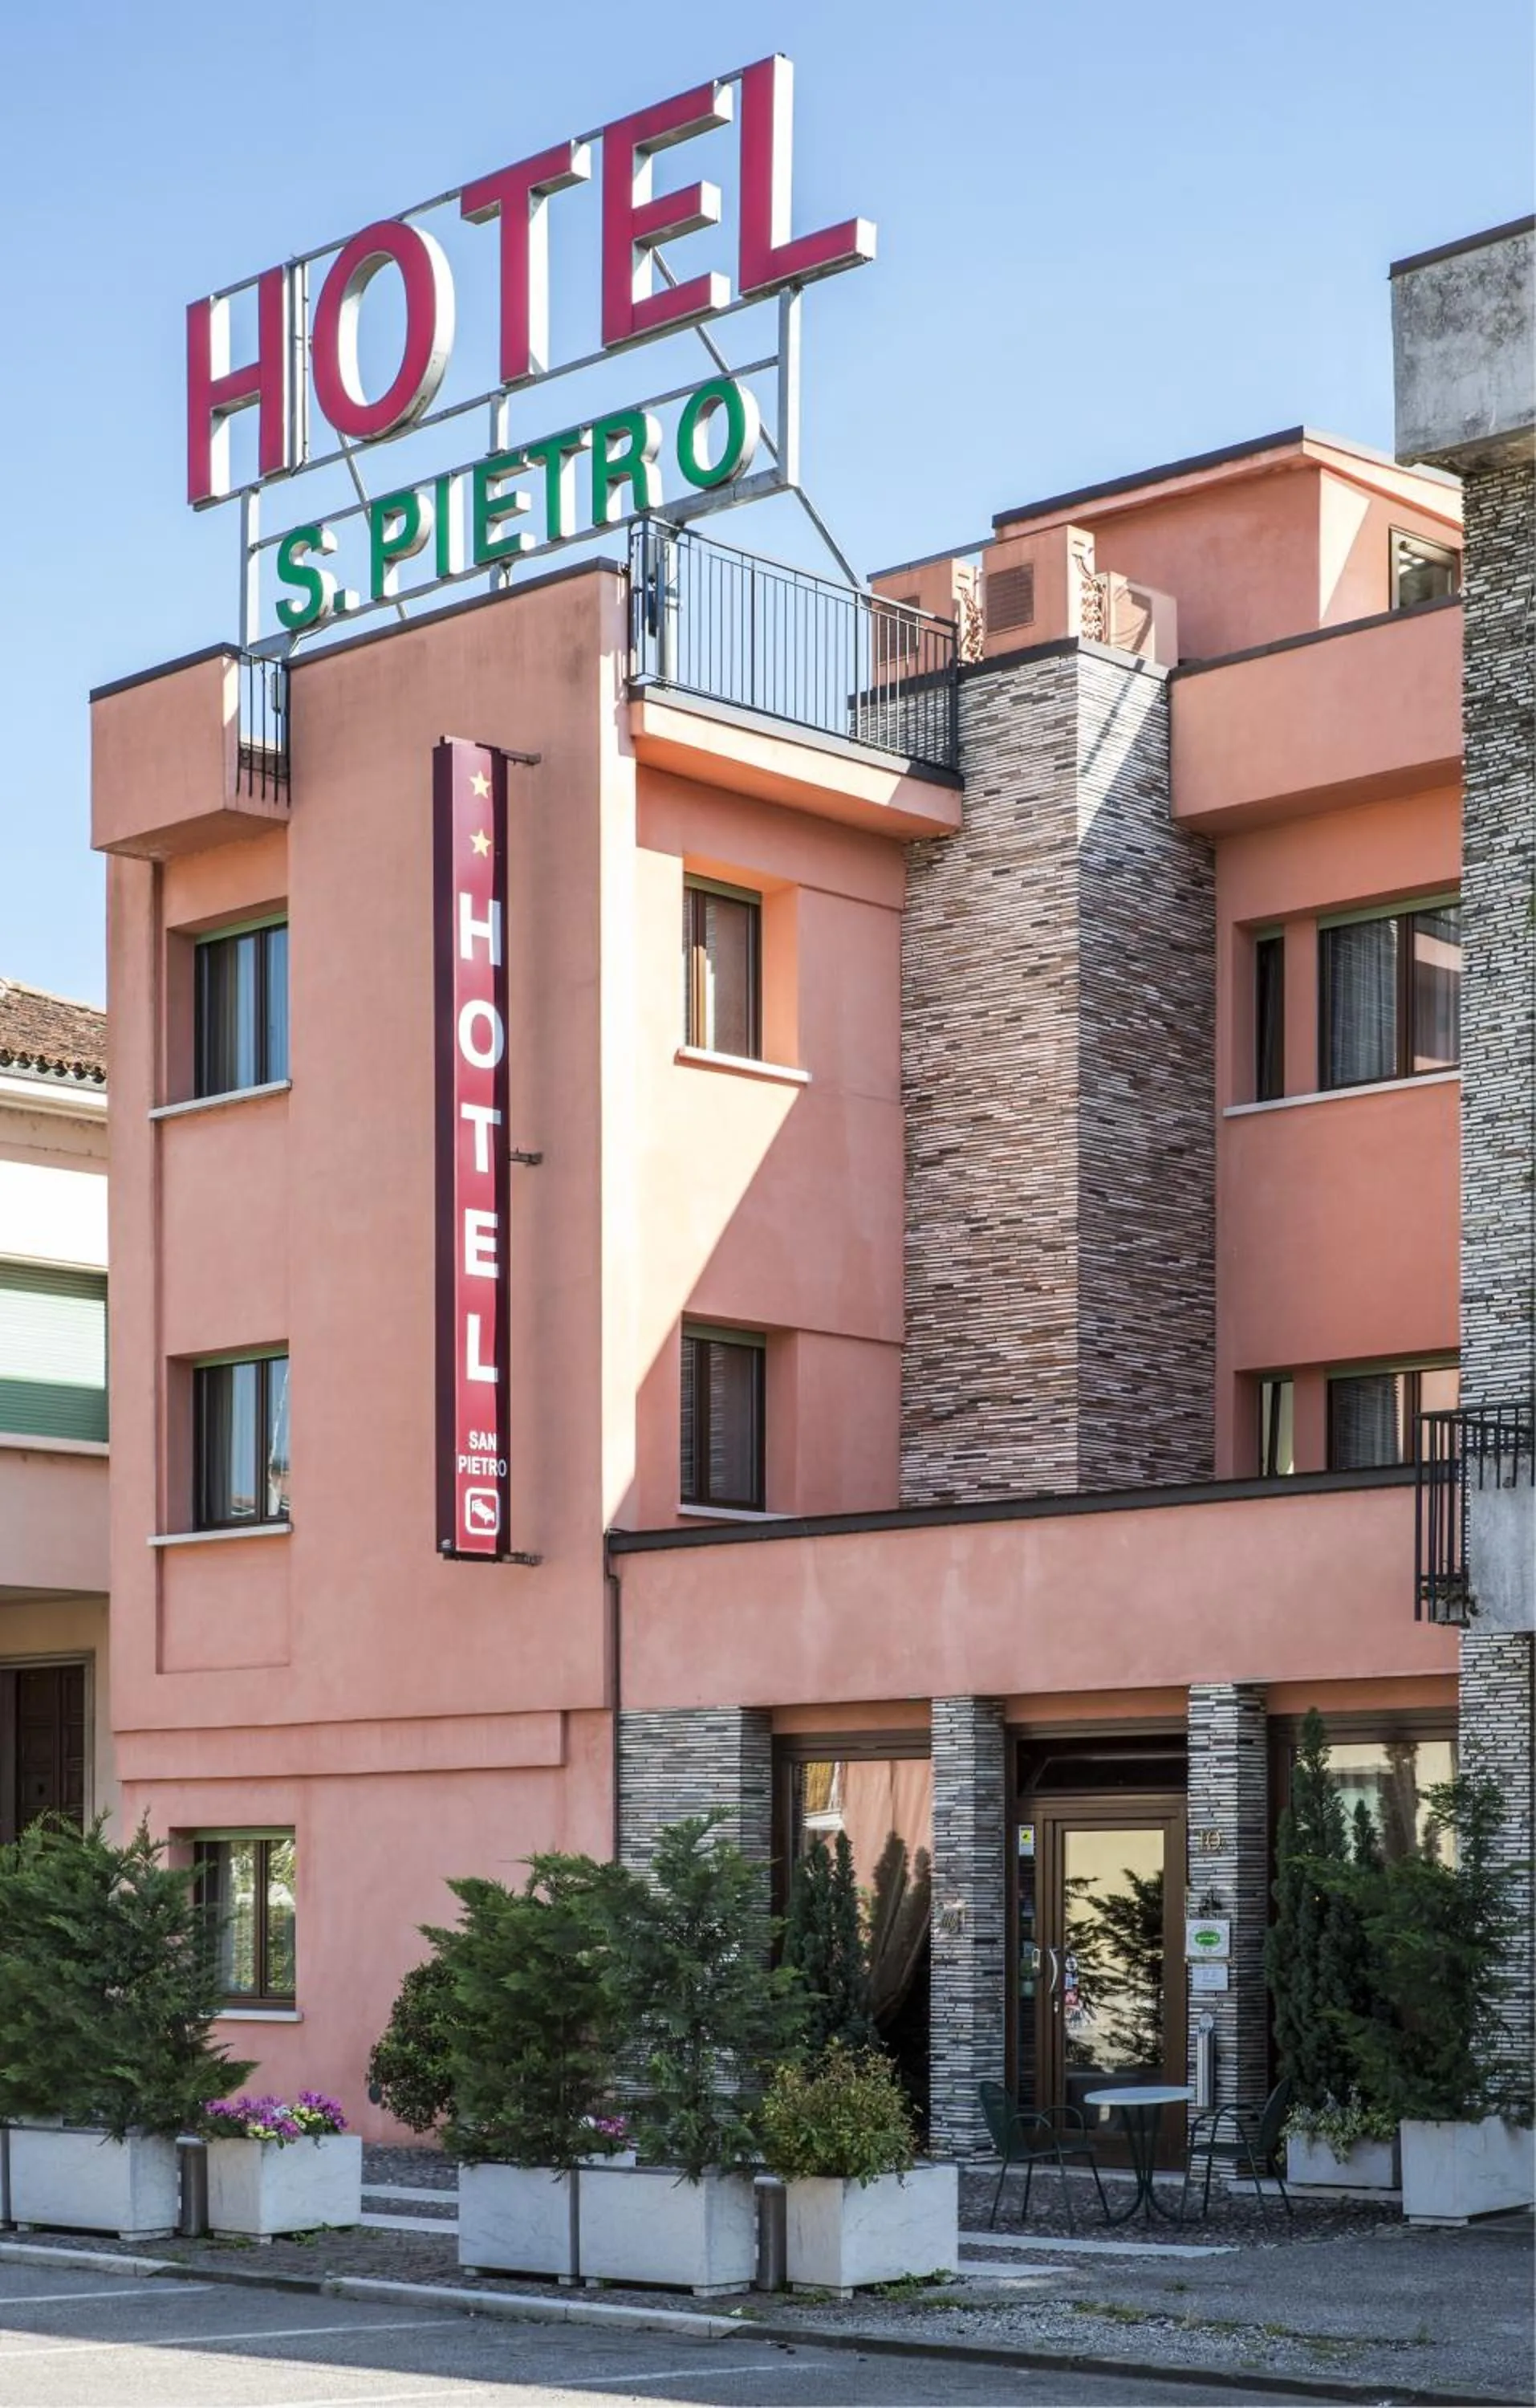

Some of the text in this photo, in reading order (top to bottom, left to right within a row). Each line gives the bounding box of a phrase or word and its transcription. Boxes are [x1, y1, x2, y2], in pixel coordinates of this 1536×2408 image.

[187, 52, 877, 511] HOTEL
[458, 892, 503, 1384] HOTEL
[457, 1454, 508, 1478] PIETRO
[469, 1430, 498, 1451] SAN
